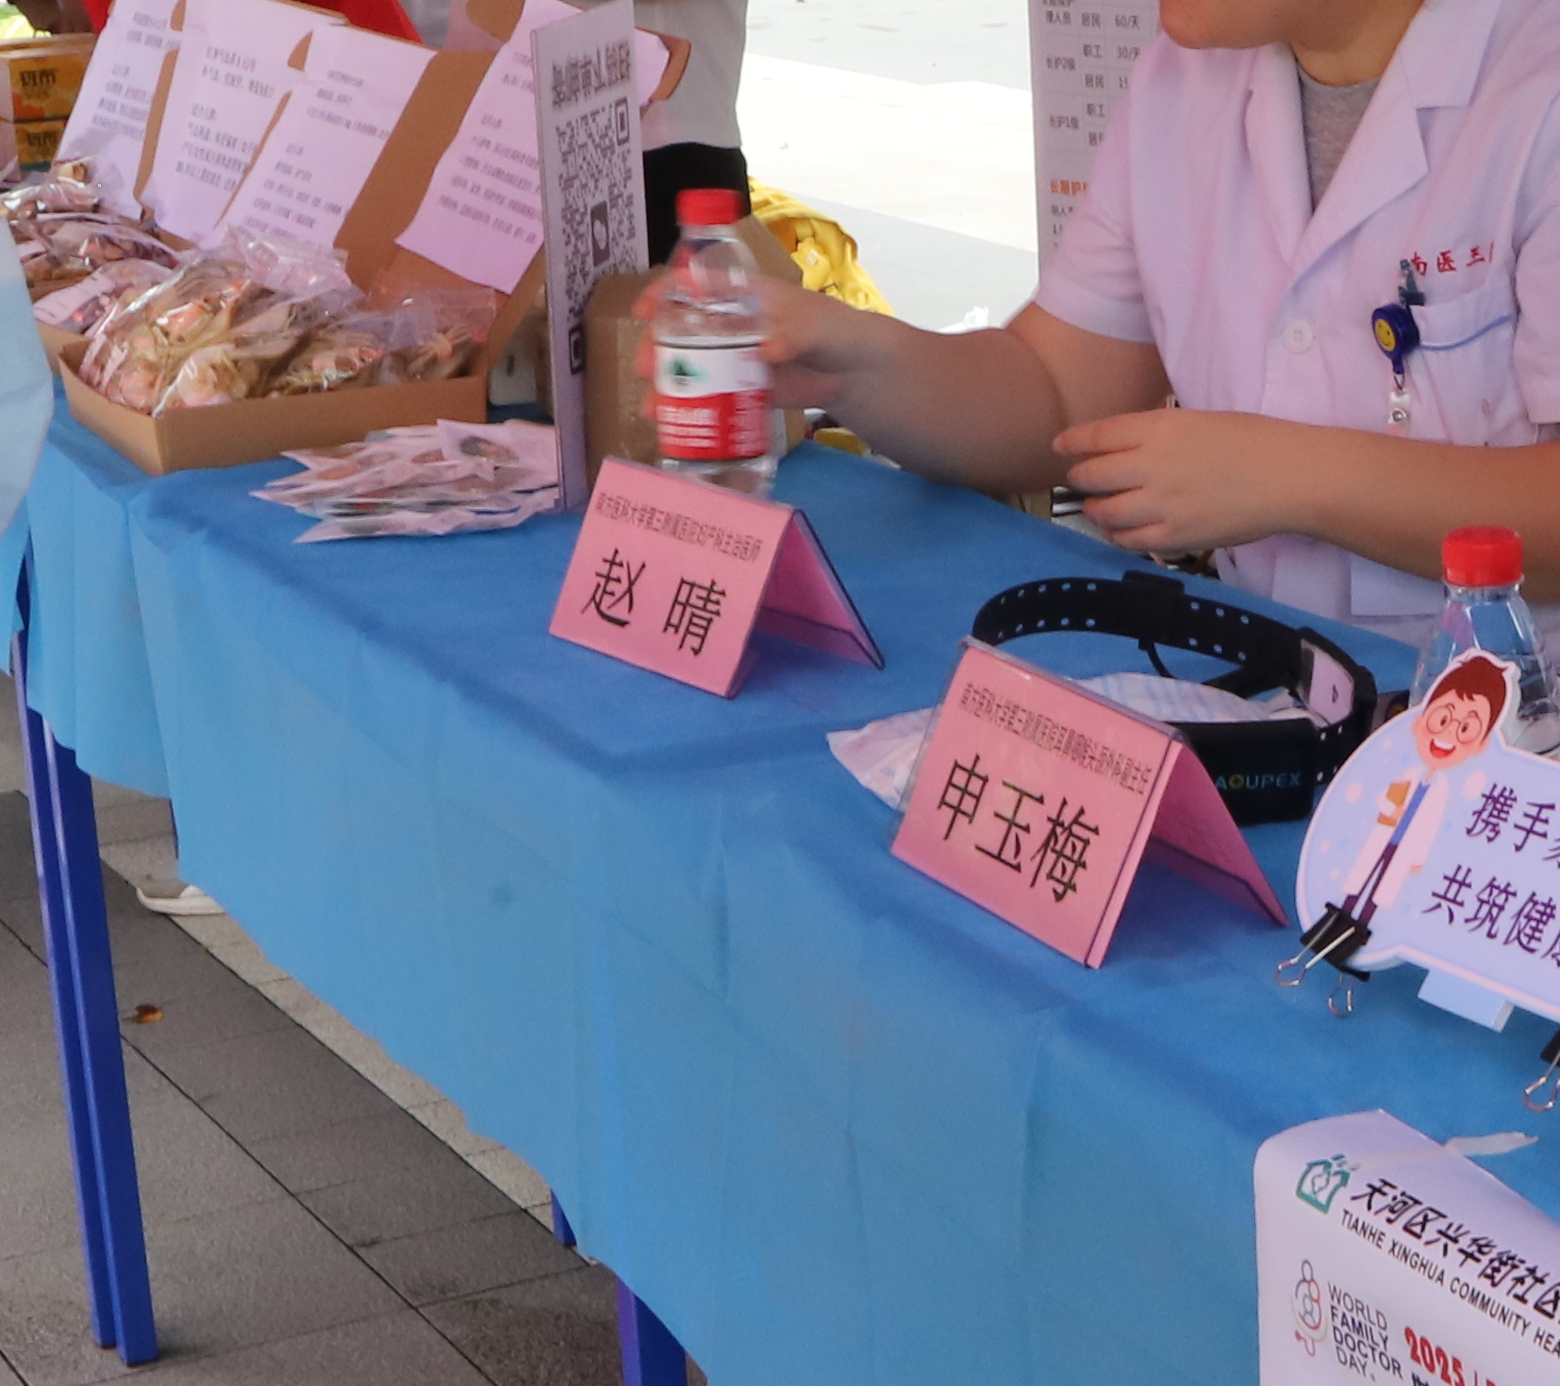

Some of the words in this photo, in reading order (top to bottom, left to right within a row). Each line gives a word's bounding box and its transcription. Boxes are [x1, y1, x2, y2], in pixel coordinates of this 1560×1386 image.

[1409, 242, 1495, 278] 南医三
[936, 752, 1101, 904] 申玉梅
[1340, 1208, 1387, 1251] TIANHE
[1387, 1236, 1446, 1288] XINGHUA
[1448, 1273, 1532, 1339] COMMUNITY
[1327, 1281, 1389, 1331] WORLD
[1329, 1303, 1390, 1352] FAMILY
[1332, 1325, 1404, 1380] DOCTOR
[1334, 1347, 1369, 1378] DAY
